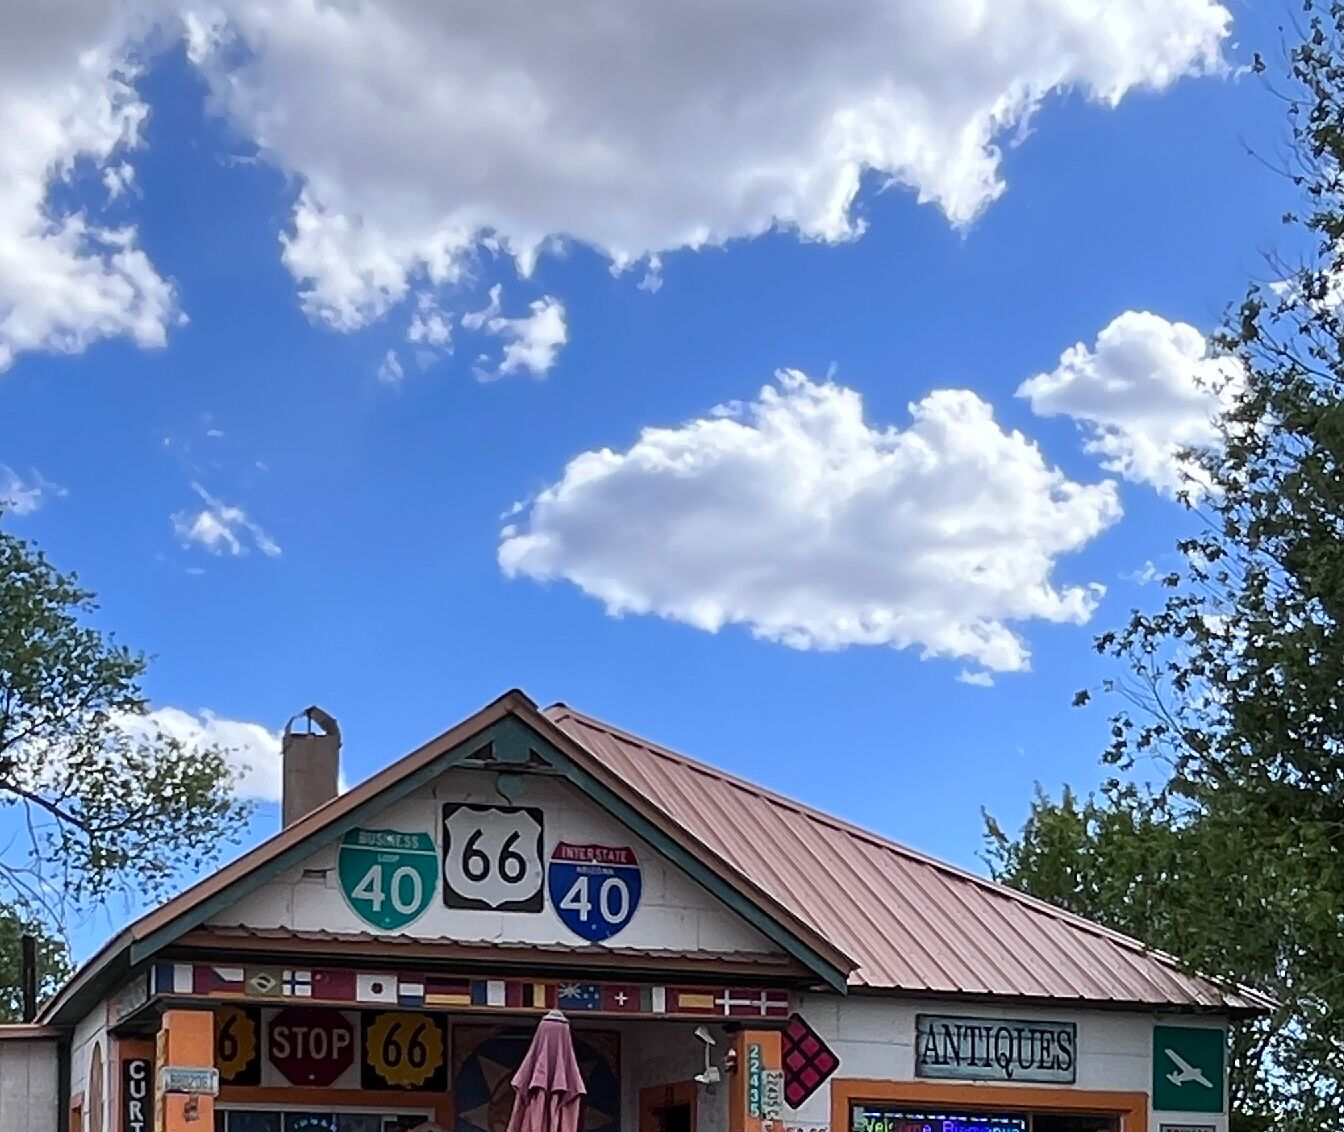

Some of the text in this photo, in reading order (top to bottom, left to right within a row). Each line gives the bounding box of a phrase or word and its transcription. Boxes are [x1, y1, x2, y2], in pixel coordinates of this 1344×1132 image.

[358, 831, 420, 849] BUSINESS
[462, 829, 527, 883] 66
[561, 846, 627, 863] INTERSTATE
[351, 864, 423, 914] 40
[560, 876, 630, 923] 40
[272, 1026, 350, 1060] STOP
[382, 1022, 427, 1068] 66
[921, 1024, 1075, 1078] ANTIQUES
[749, 1045, 759, 1117] 22435
